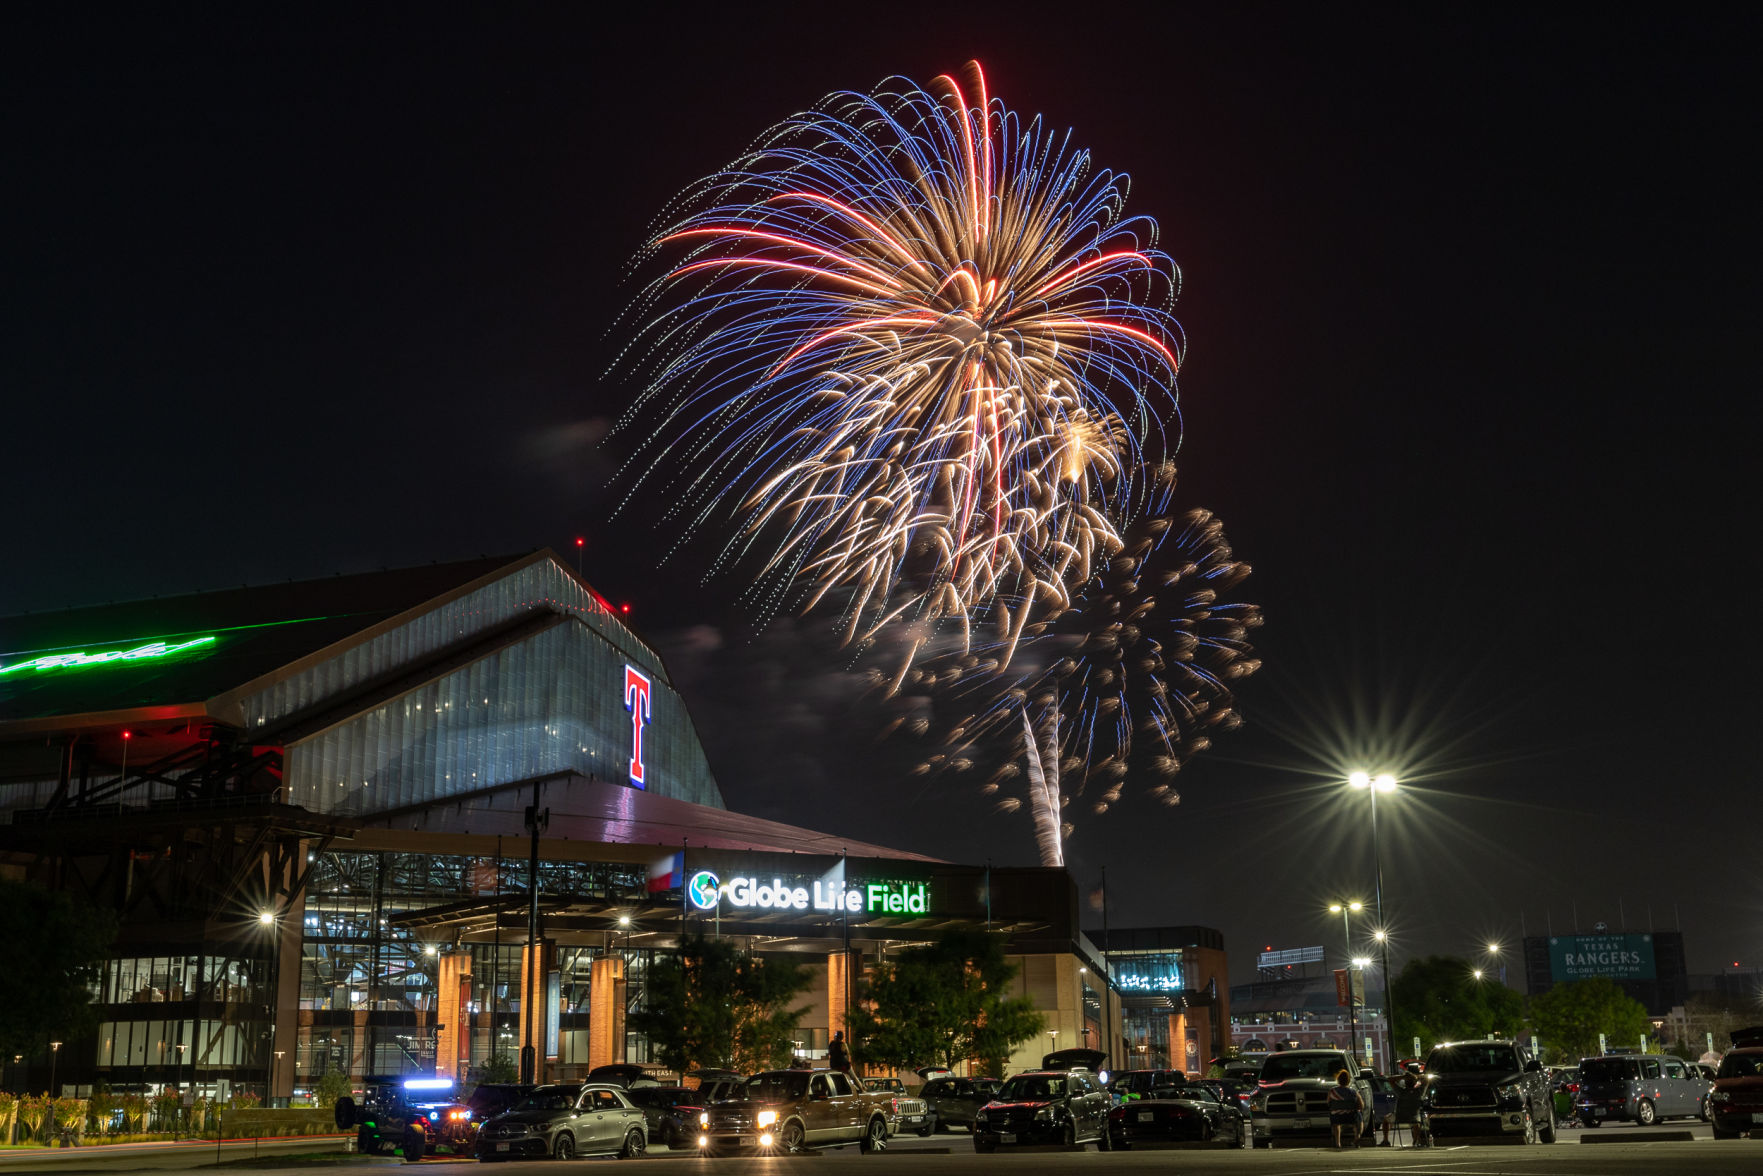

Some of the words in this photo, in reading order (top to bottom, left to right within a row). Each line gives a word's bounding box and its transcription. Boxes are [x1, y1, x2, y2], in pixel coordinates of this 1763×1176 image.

[625, 664, 651, 788] T
[728, 878, 809, 909] Globe
[867, 883, 925, 913] Field
[1566, 952, 1640, 966] RANGERS
[1566, 966, 1594, 974] GLOBE
